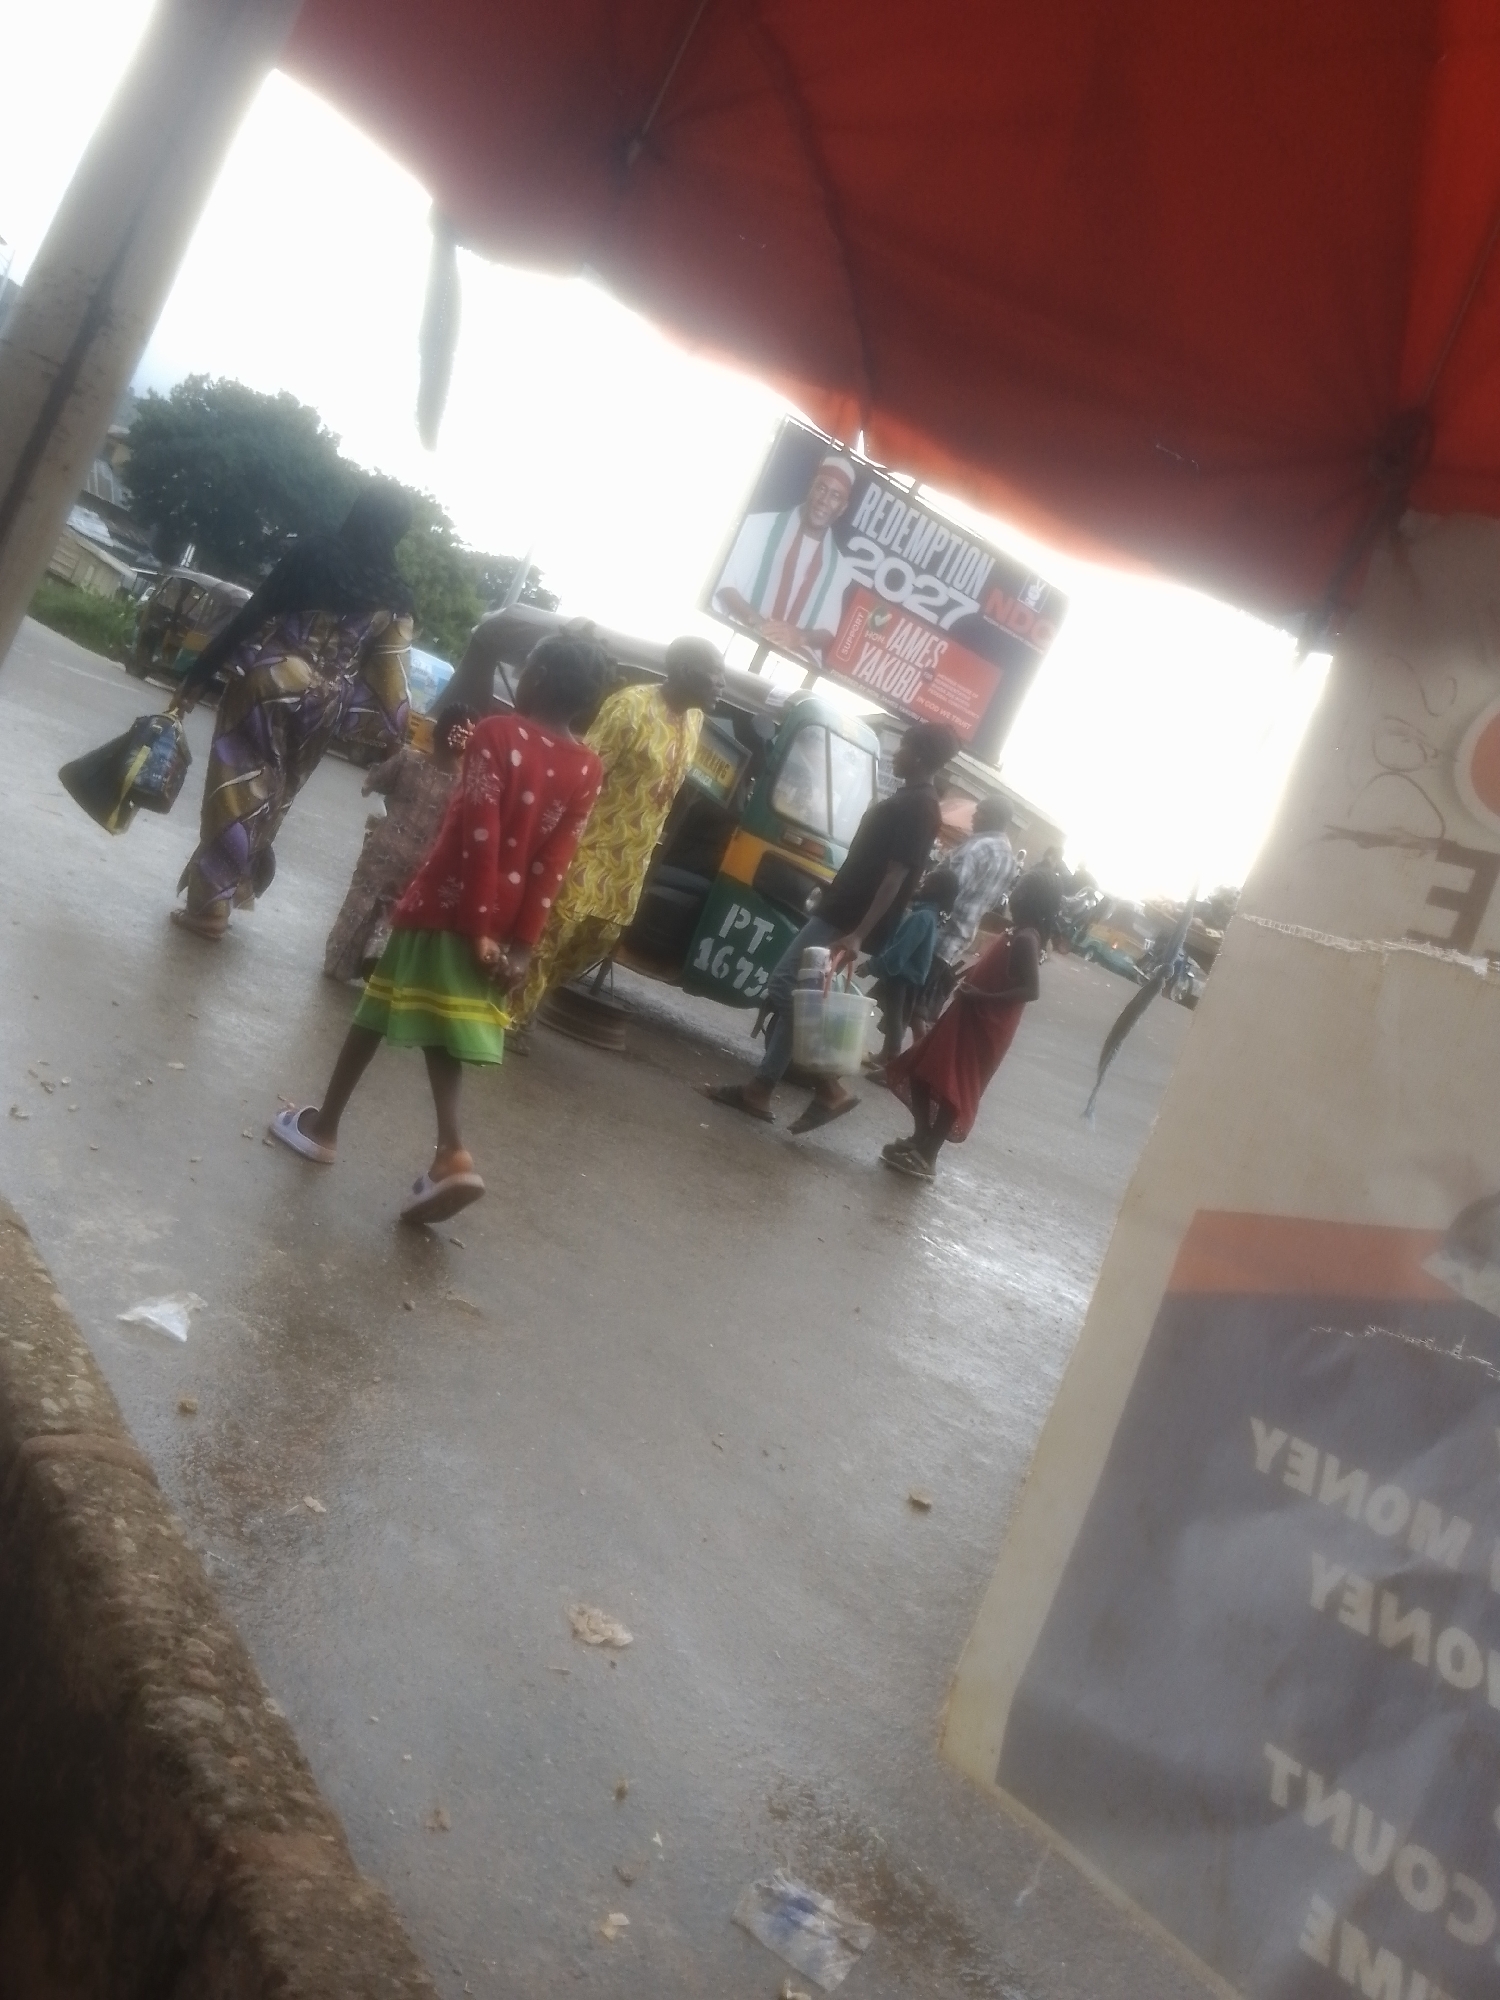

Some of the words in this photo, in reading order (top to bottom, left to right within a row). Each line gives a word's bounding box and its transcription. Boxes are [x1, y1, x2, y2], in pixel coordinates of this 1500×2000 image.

[852, 482, 996, 600] REDEMPTION
[847, 536, 981, 631] 2027
[841, 612, 865, 656] SUPPORT
[886, 617, 948, 669] JAMES
[852, 641, 923, 704] YAKUBU
[924, 700, 940, 713] GOD
[940, 709, 951, 719] WE
